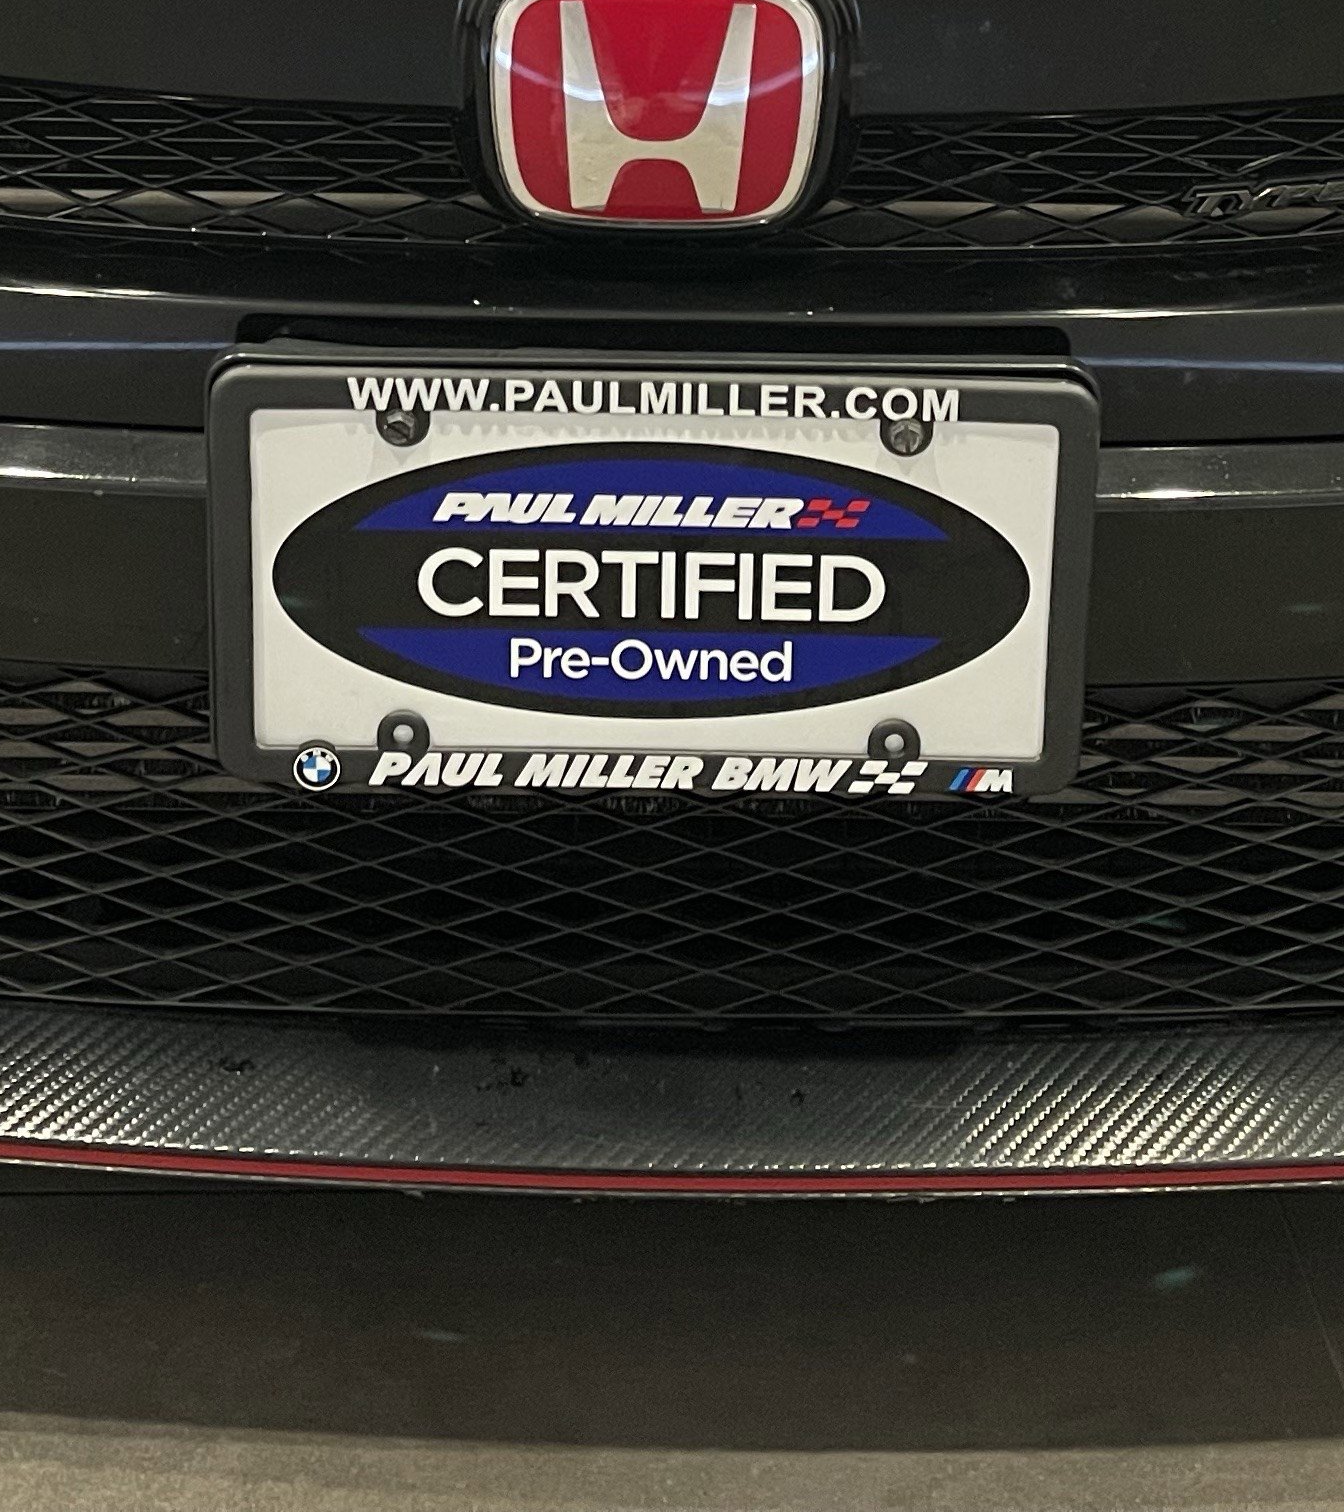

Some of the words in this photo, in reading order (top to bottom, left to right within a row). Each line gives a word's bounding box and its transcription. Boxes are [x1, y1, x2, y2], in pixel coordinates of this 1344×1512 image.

[346, 376, 960, 423] WWW.PAULMILLER.COM
[432, 492, 578, 525] PAUL
[579, 494, 805, 530] MILLER
[417, 547, 886, 623] CERTIFIED
[509, 637, 793, 683] Pre-Owned
[368, 751, 505, 787] PAUL
[513, 754, 704, 791] MILLER
[710, 756, 854, 793] BMW
